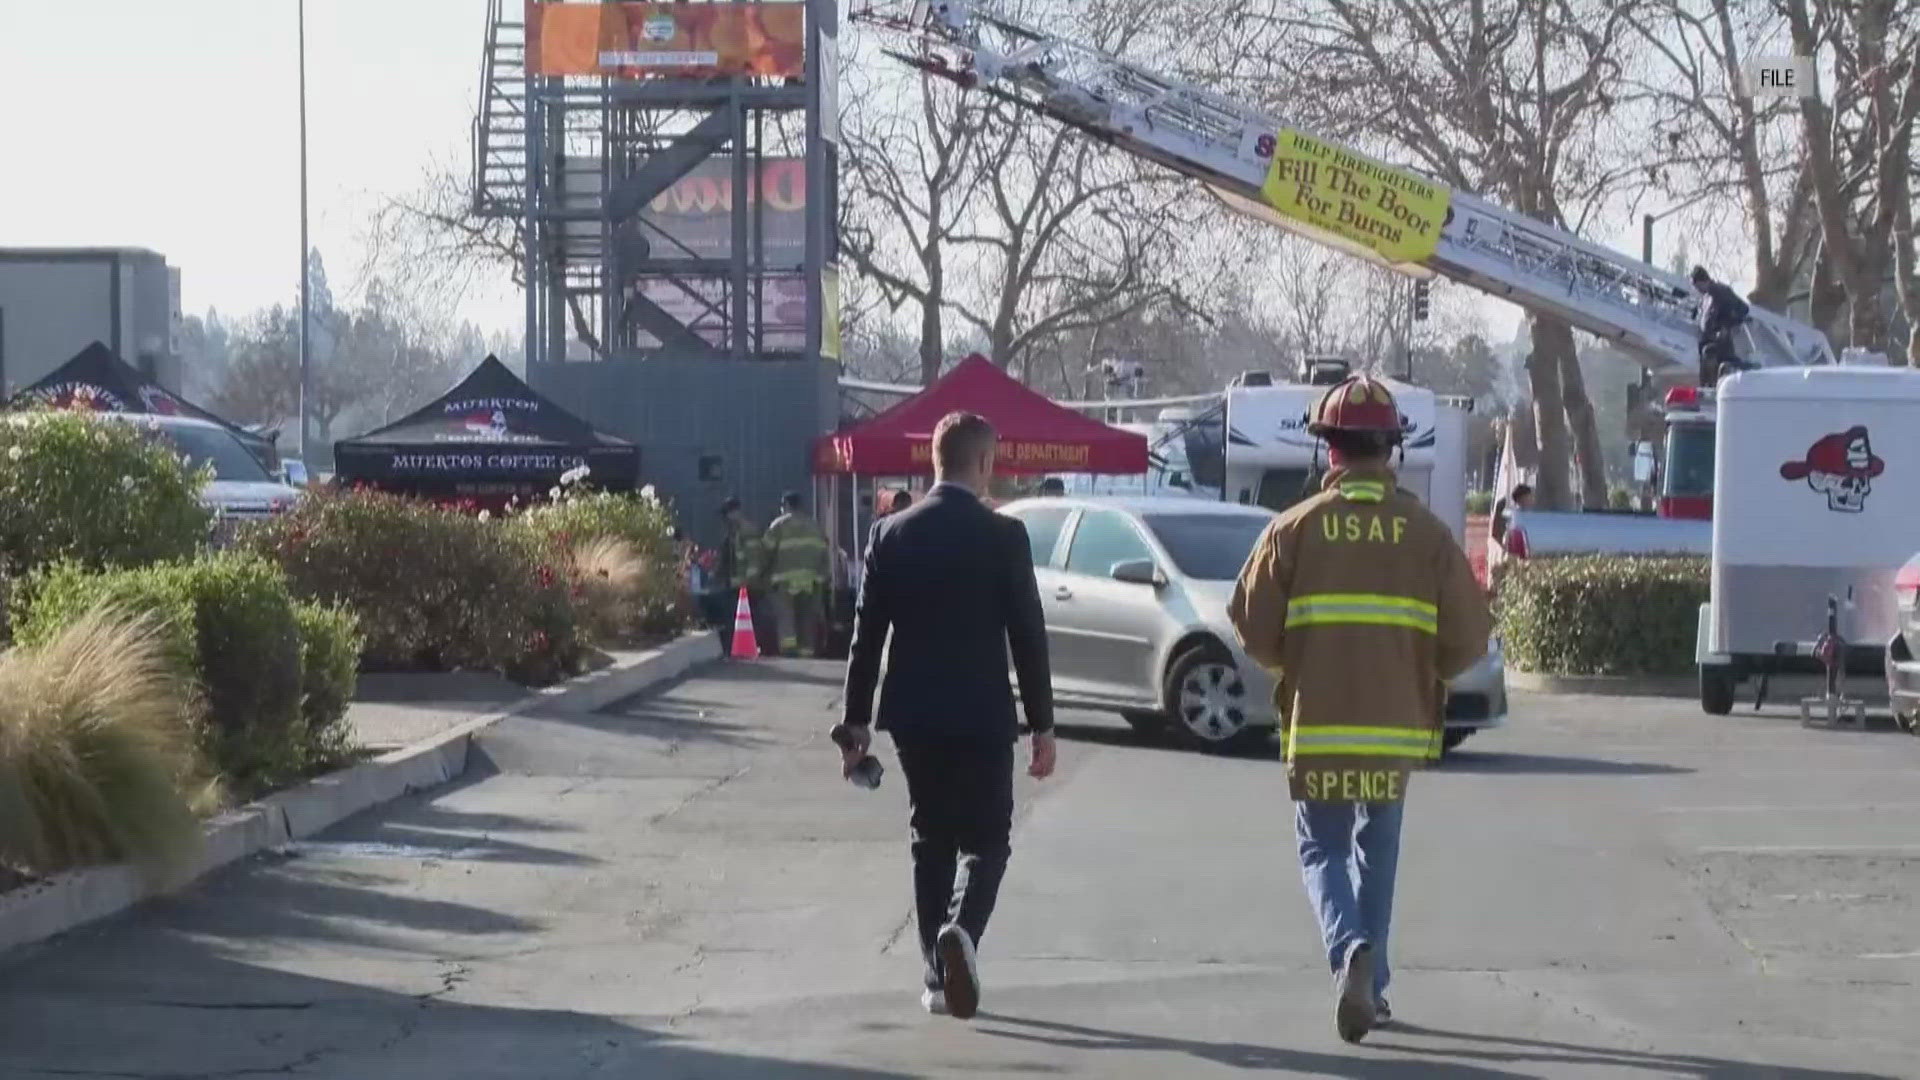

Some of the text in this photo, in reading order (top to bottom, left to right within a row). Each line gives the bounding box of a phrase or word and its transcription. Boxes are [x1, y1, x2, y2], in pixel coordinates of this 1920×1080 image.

[1278, 157, 1319, 185] Fill
[1325, 164, 1371, 201] The
[1293, 134, 1435, 200] HELP FIREFIGHTERS
[1294, 182, 1333, 215] For
[1337, 199, 1403, 244] Burns
[392, 454, 482, 470] MUERTOS
[487, 454, 556, 469] COFFEE
[1016, 442, 1090, 466] DEPARTMENT
[1322, 512, 1408, 545] USAF
[1304, 769, 1400, 801] SPENCE
